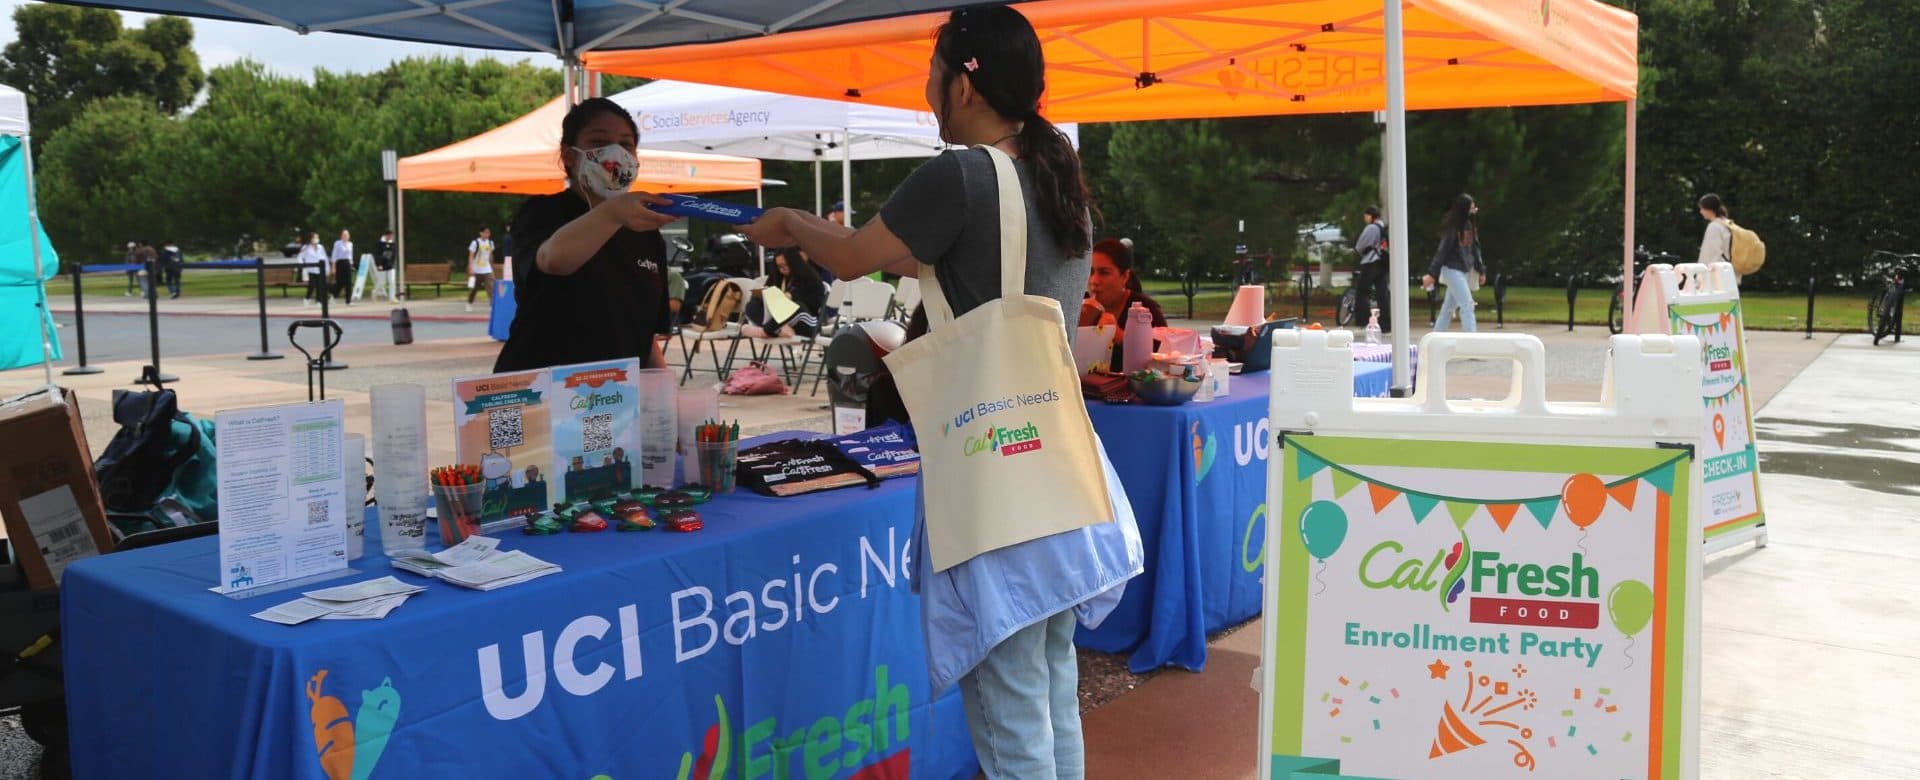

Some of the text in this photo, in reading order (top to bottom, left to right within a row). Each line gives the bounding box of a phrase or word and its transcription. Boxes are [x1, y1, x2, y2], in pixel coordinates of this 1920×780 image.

[954, 389, 1060, 428] UCI Basic Needs
[1499, 606, 1569, 621] FOOD
[477, 604, 644, 721] UCI
[670, 554, 841, 664] Basic
[1344, 622, 1603, 667] Enrollment Party
